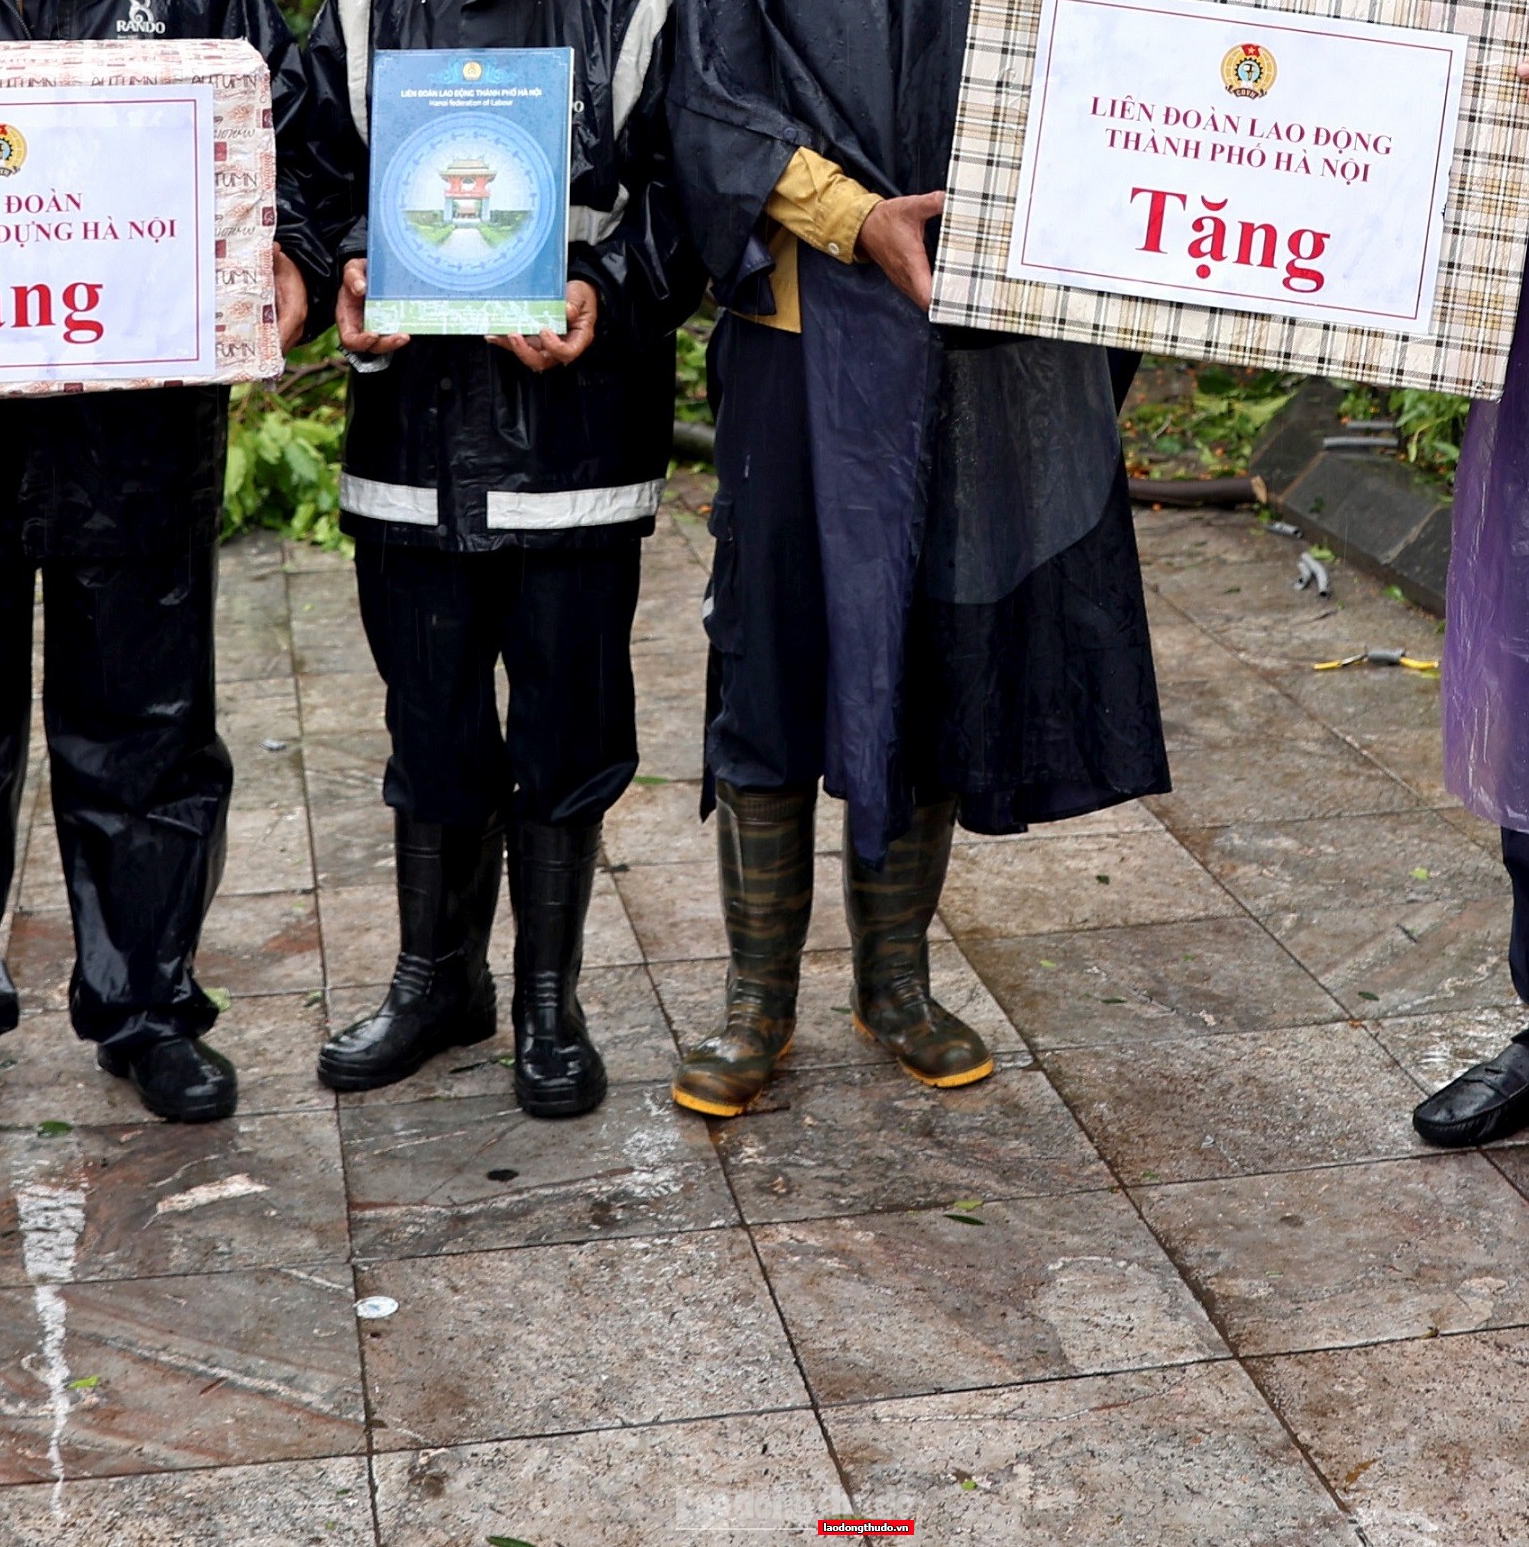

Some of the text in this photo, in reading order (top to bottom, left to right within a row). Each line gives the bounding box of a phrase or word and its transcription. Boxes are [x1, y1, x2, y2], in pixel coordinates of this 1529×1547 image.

[116, 19, 166, 34] RANDO
[1090, 95, 1393, 155] LIÊN ĐOÀN LAO ĐỘNG
[1105, 128, 1371, 186] THÀNH PHỐ HÀ NỘI
[5, 188, 82, 214] ĐOÀN
[82, 218, 120, 241] HÀ
[129, 218, 176, 244] NỘI
[1129, 187, 1331, 293] Tặng
